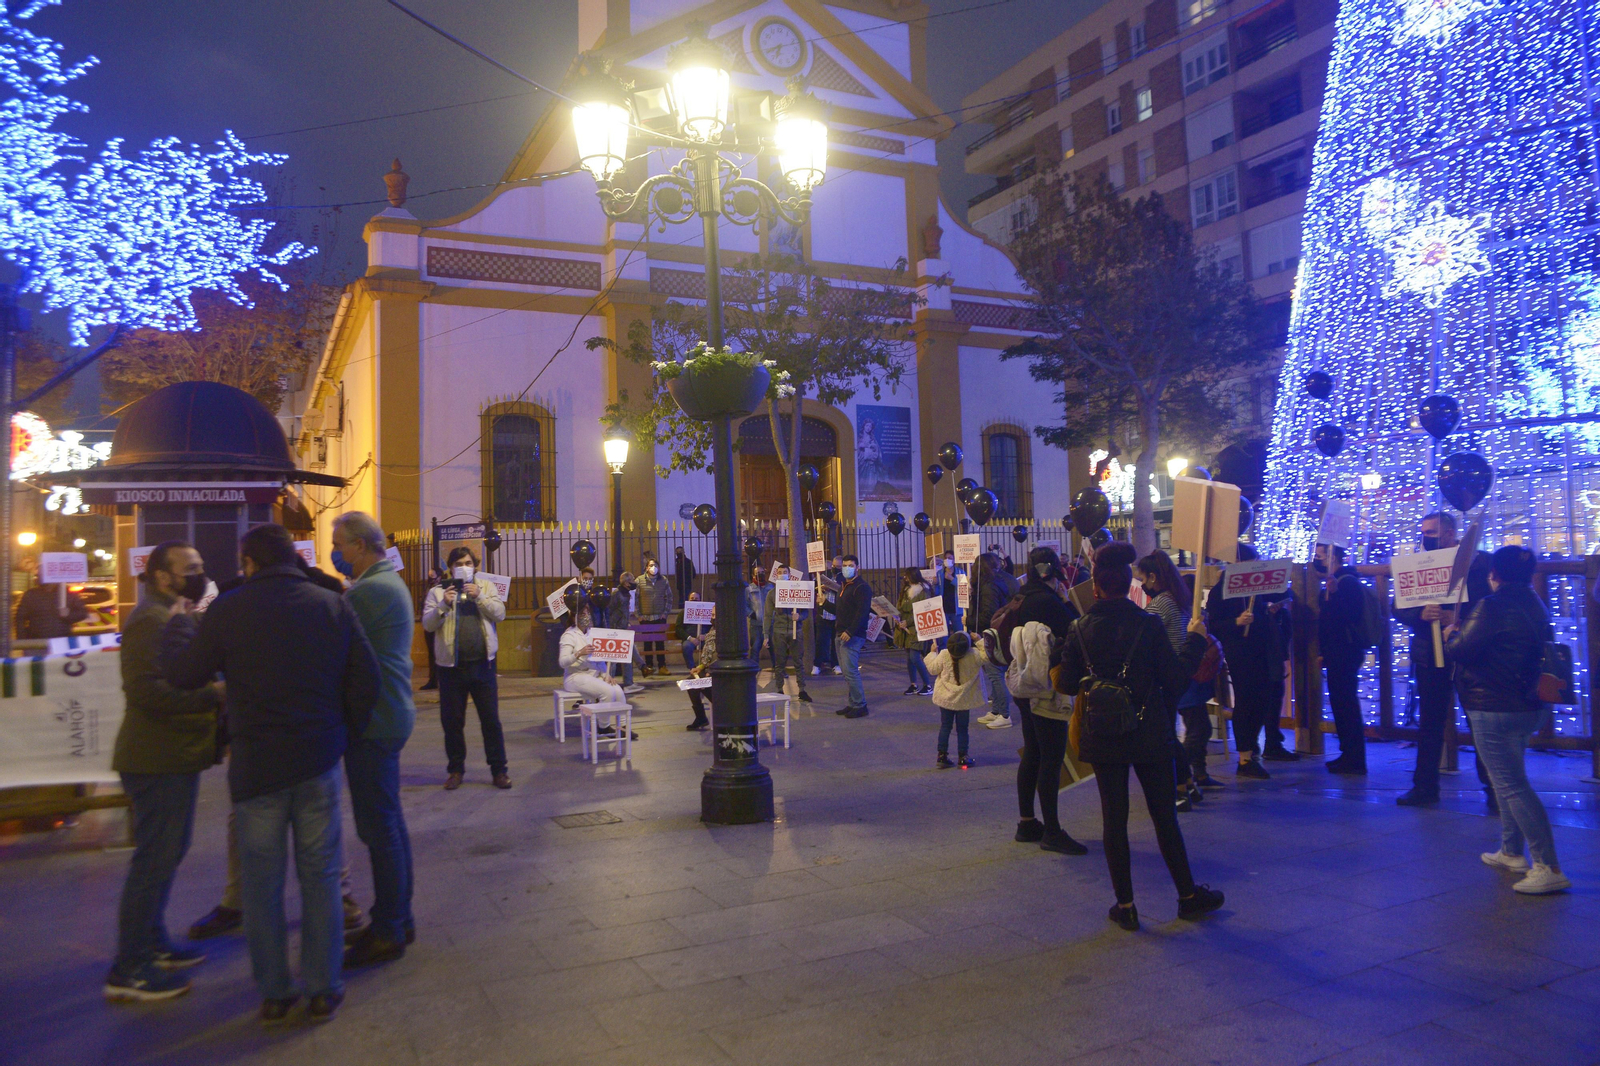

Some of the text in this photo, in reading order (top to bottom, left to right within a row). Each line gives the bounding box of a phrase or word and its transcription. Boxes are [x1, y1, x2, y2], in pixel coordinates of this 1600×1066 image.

[116, 490, 246, 502] KIOSCO INMACULADA
[1230, 570, 1285, 588] S.O.S
[1400, 572, 1414, 588] SE
[779, 589, 811, 598] SE VENDE
[1229, 585, 1281, 594] HOSTELERIA
[917, 610, 943, 628] S.O.S
[592, 639, 630, 652] S.O.S
